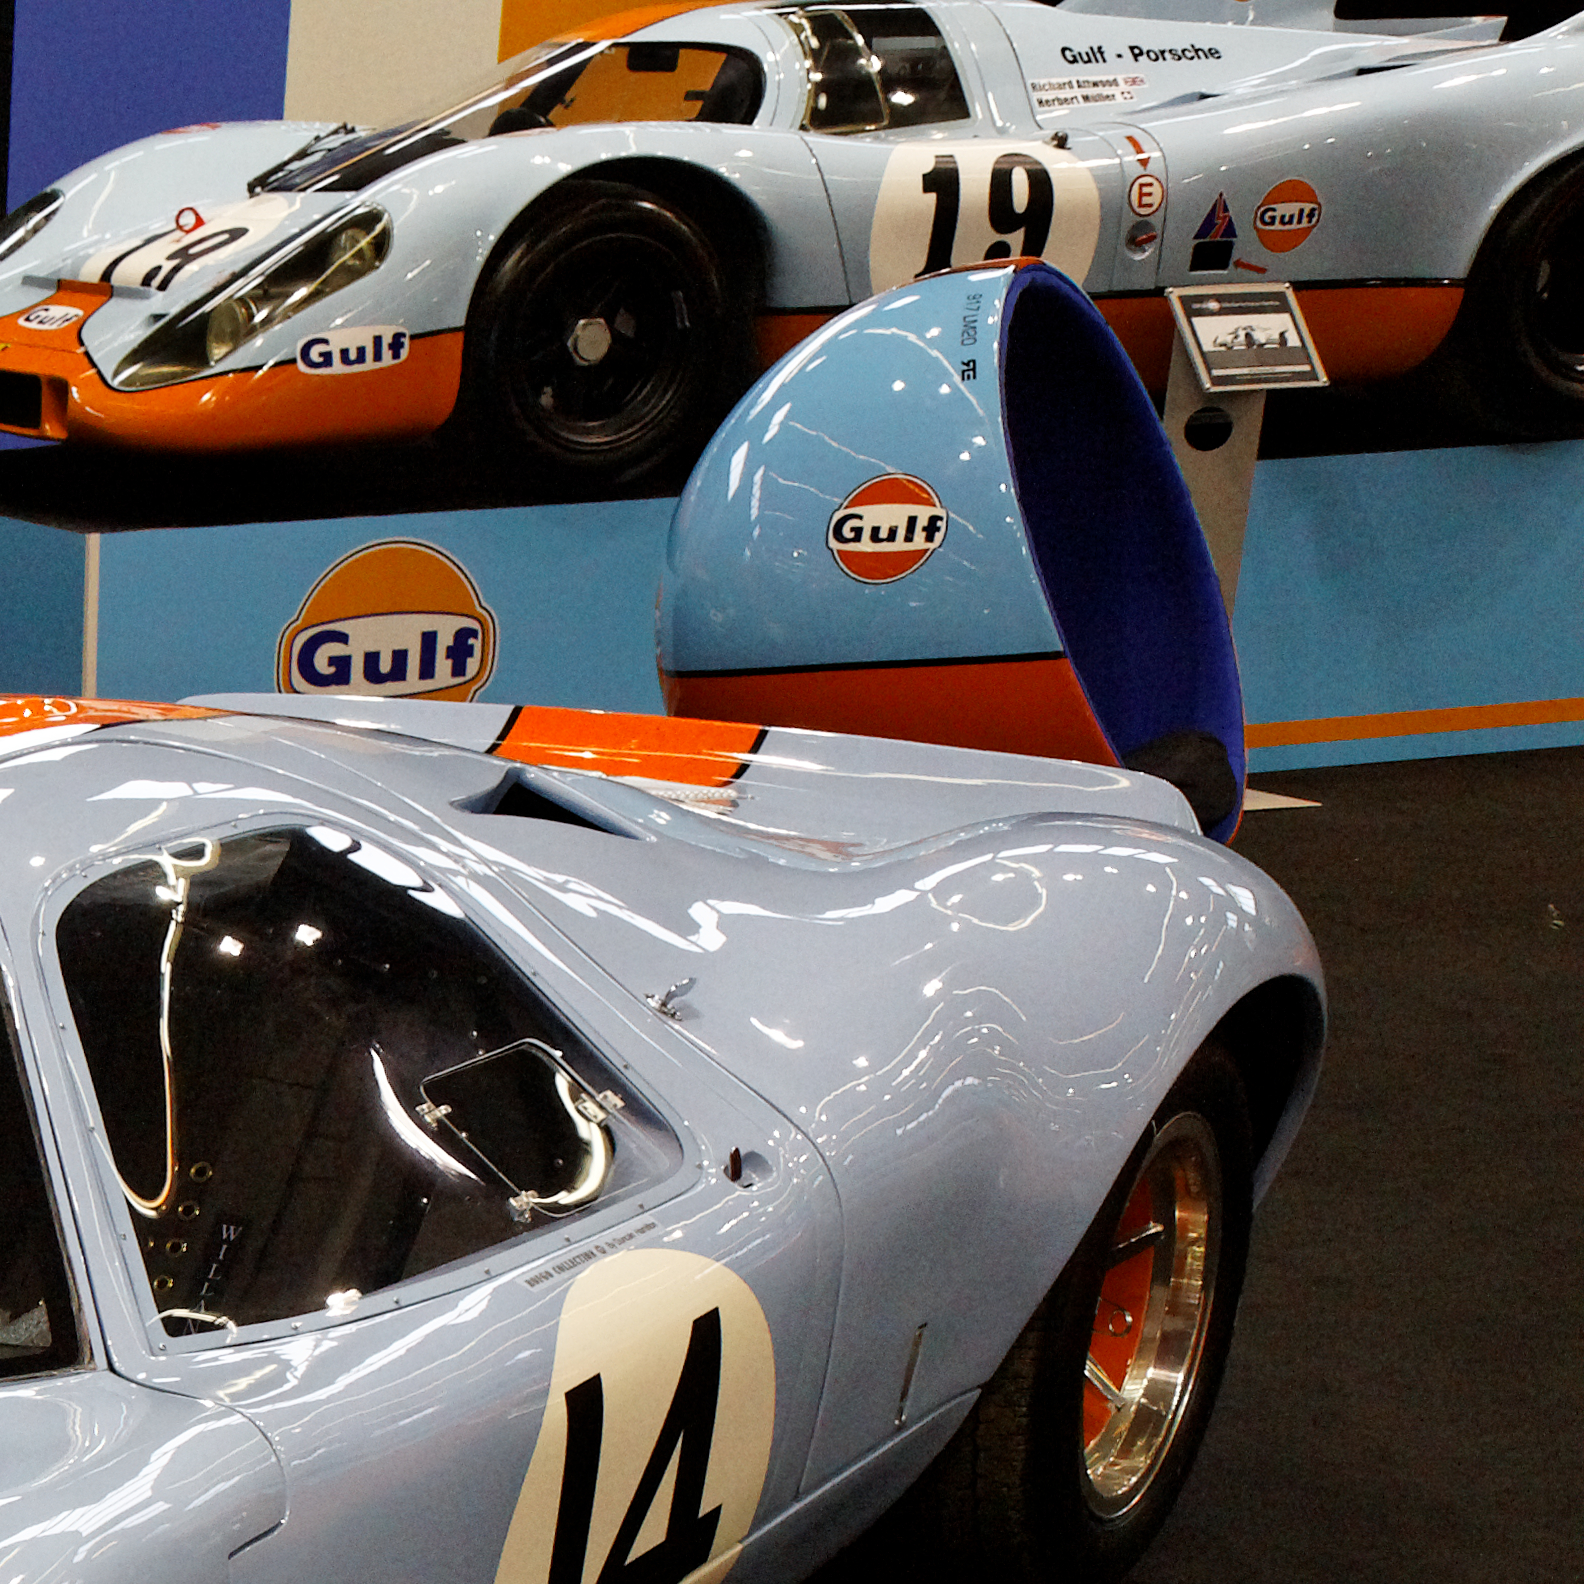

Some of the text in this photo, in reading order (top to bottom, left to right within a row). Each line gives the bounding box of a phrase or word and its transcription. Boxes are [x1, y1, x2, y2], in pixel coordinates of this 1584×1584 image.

[1061, 45, 1108, 64] Gulf
[1129, 44, 1222, 62] Porsche
[1031, 80, 1074, 93] Richard
[1037, 95, 1079, 108] Herbert
[1138, 183, 1153, 208] E
[914, 153, 1055, 279] 19
[1259, 207, 1317, 226] Gulf
[25, 307, 80, 326] Gulf
[300, 332, 407, 369] Gulf
[832, 513, 944, 544] Gulf
[296, 626, 480, 687] Gulf
